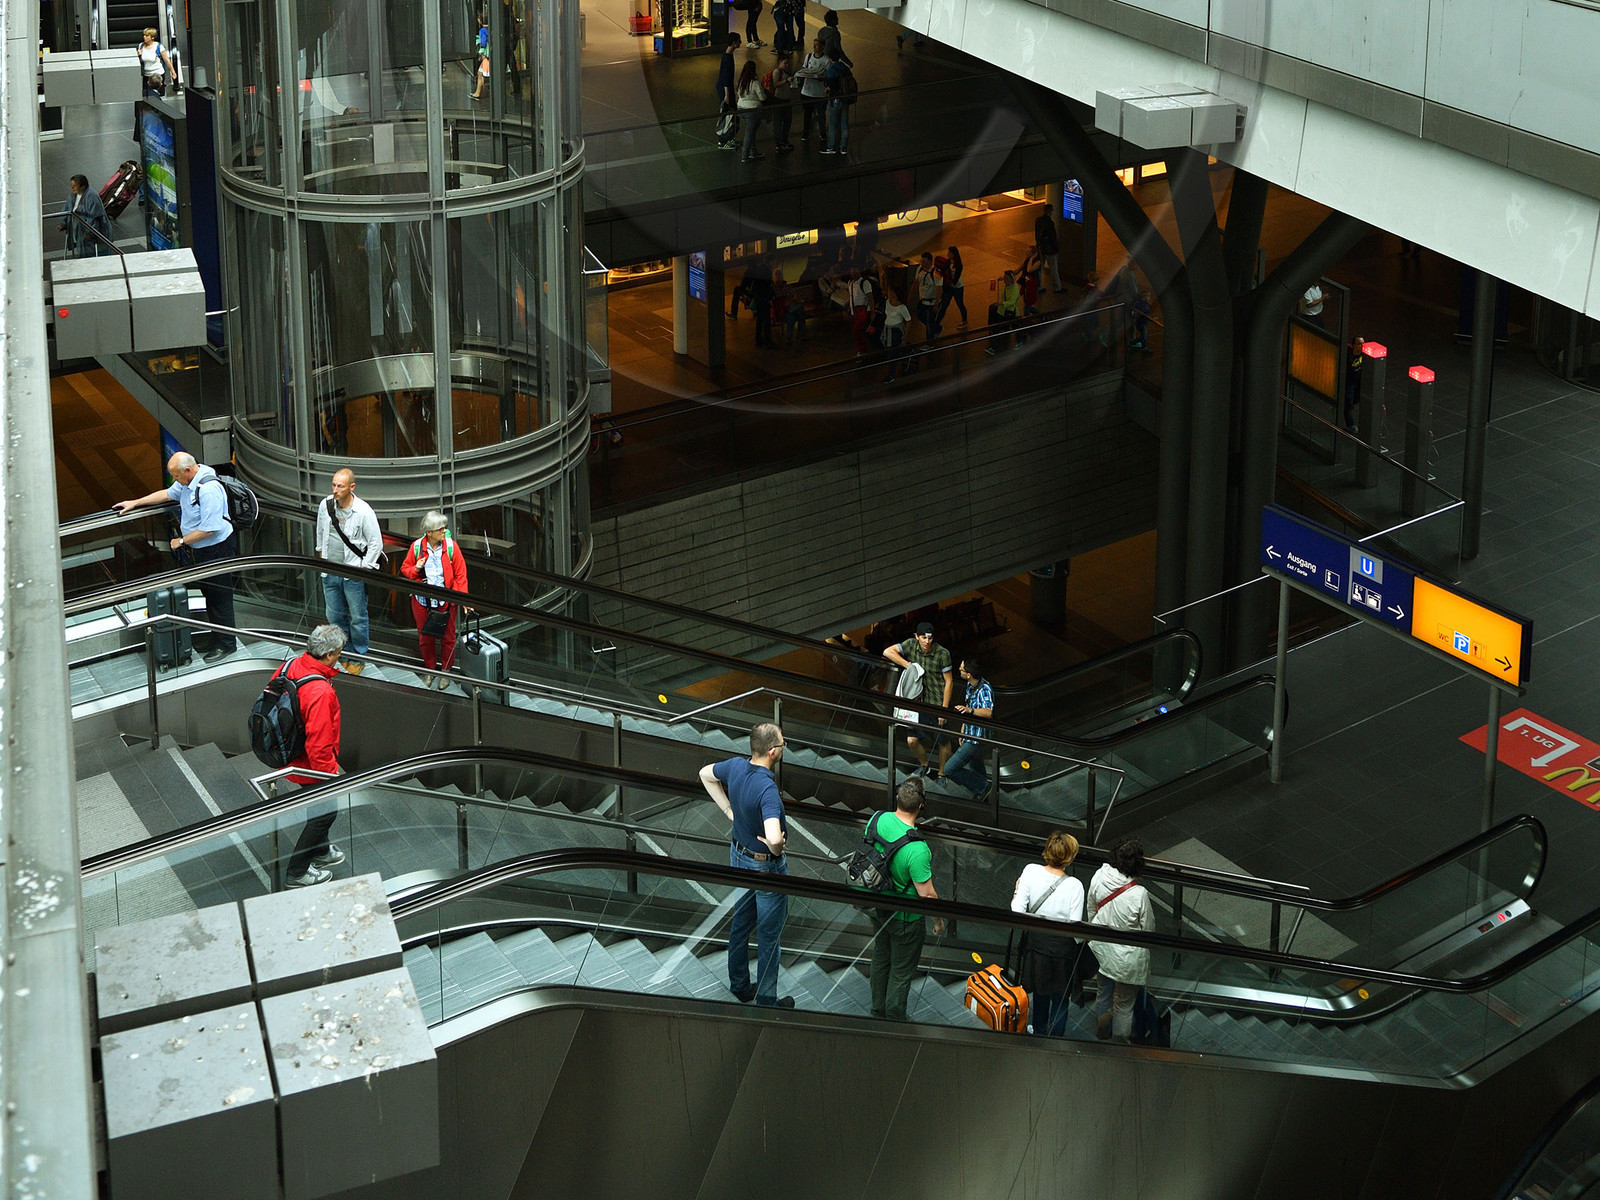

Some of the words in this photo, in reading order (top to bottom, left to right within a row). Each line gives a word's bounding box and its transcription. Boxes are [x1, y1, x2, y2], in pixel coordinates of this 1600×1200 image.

[1287, 551, 1317, 574] Ausgang
[1362, 561, 1373, 575] U
[1438, 632, 1450, 643] WC
[1520, 729, 1529, 738] 1.
[1532, 735, 1556, 749] UG
